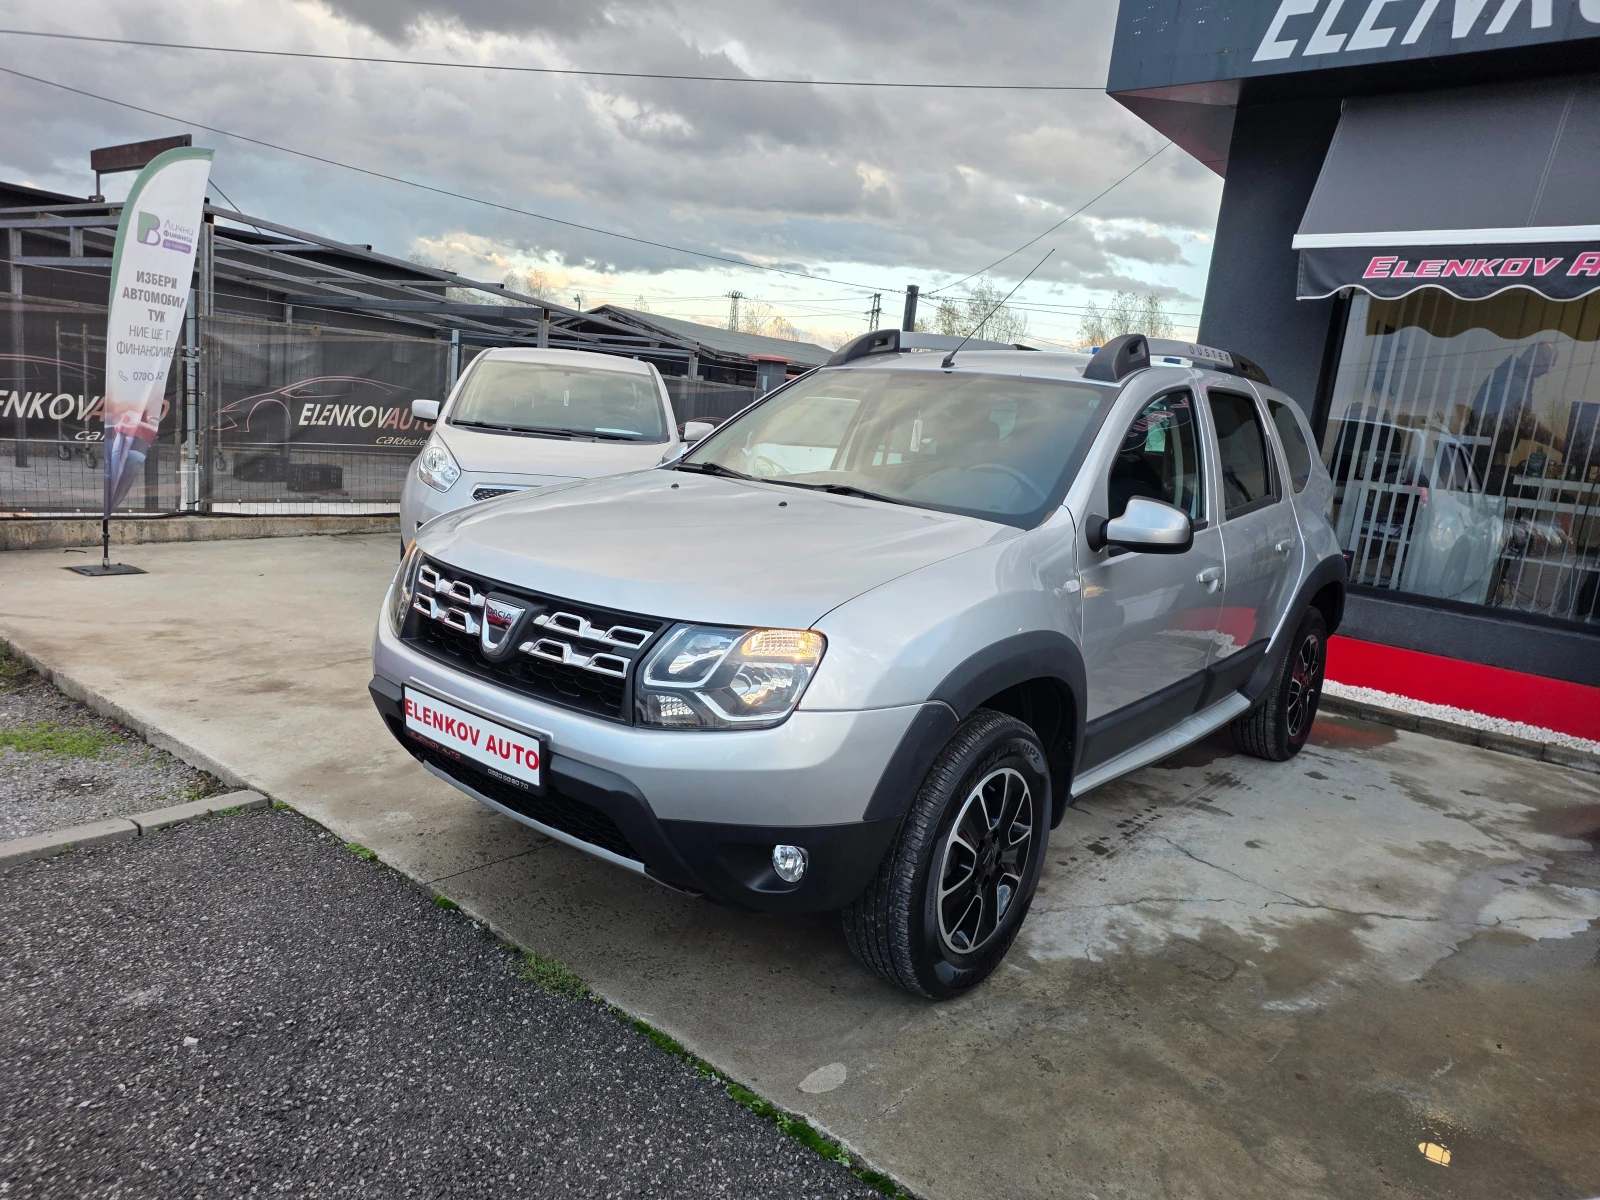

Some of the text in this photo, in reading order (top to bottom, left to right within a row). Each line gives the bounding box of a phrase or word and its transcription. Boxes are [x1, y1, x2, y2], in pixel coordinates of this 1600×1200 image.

[1362, 255, 1563, 279] ELENKOV
[136, 270, 177, 289] ИЗБЕРИ
[147, 308, 167, 323] ТУК
[129, 325, 150, 339] НИЕ
[1188, 344, 1231, 363] DUSTER
[486, 606, 513, 620] DACIA
[404, 697, 540, 771] ELENKOV AUTO
